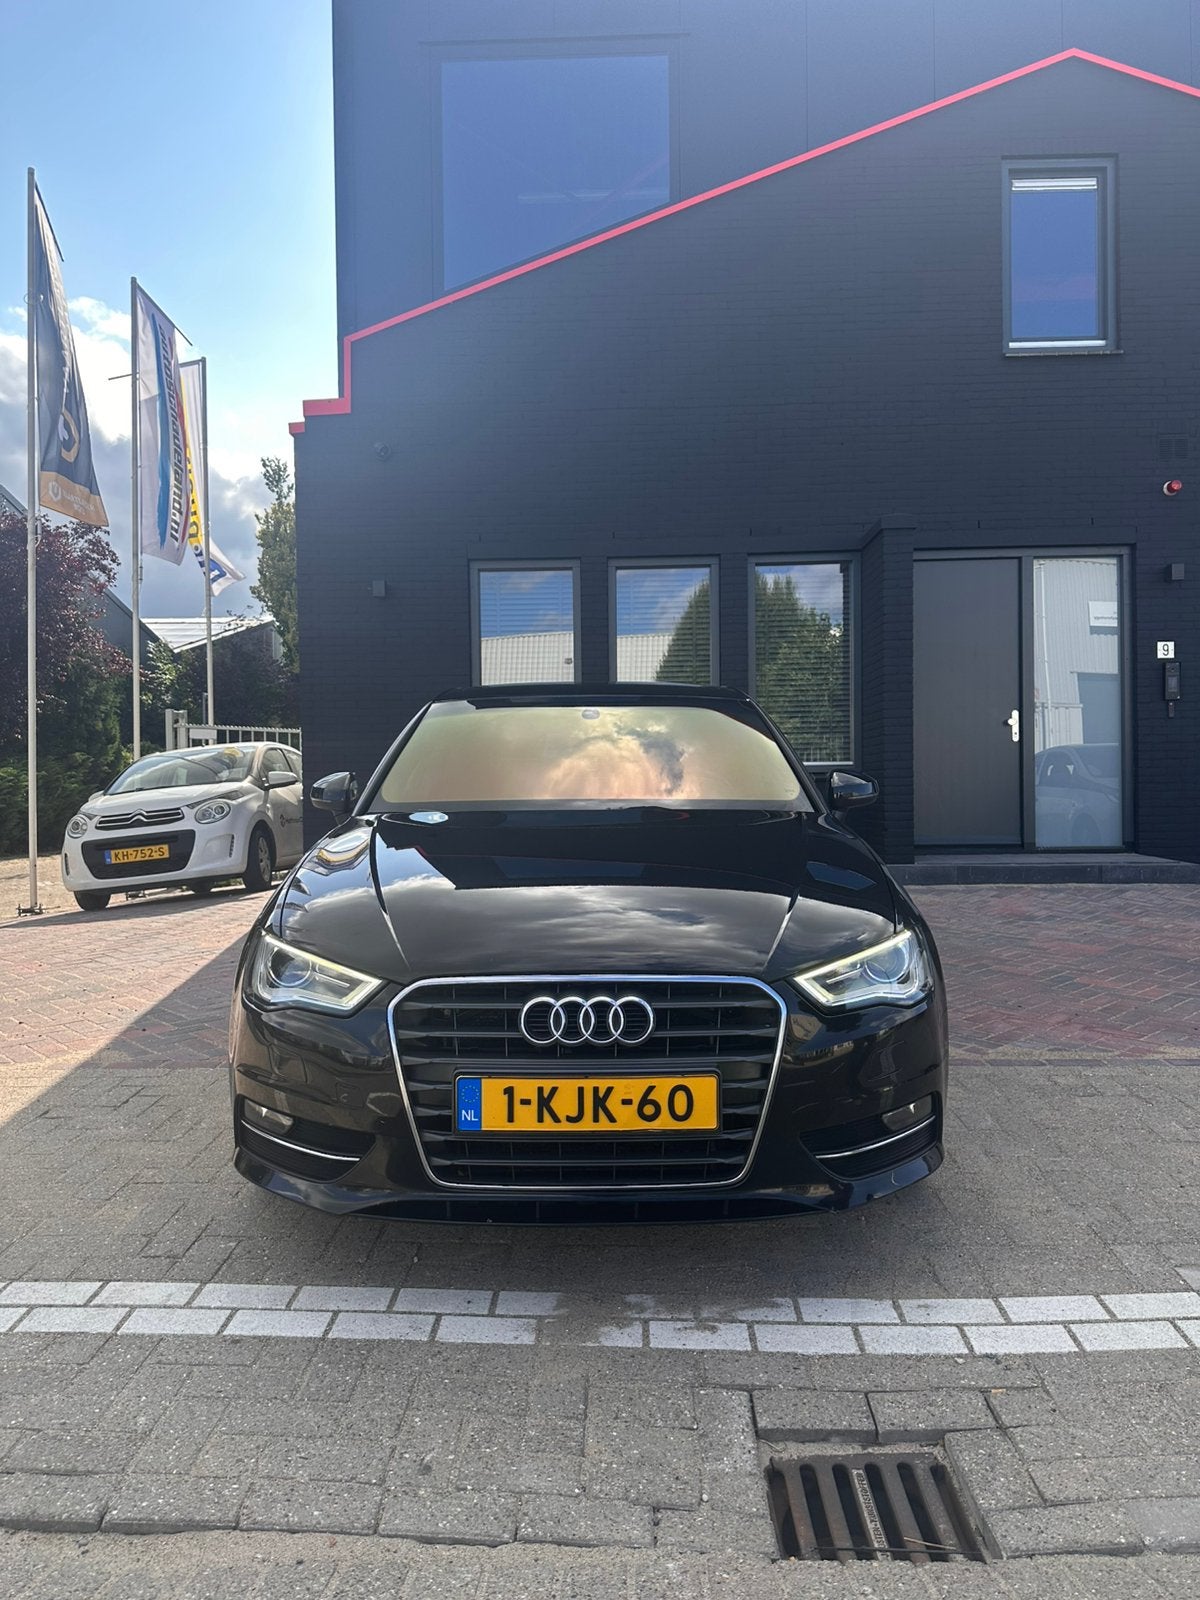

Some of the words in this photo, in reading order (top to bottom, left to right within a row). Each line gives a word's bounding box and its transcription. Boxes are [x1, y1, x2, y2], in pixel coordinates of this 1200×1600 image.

[1162, 643, 1170, 656] 9
[114, 846, 165, 861] KH-752-S
[502, 1083, 694, 1124] 1-KJK-60
[461, 1109, 479, 1122] NL
